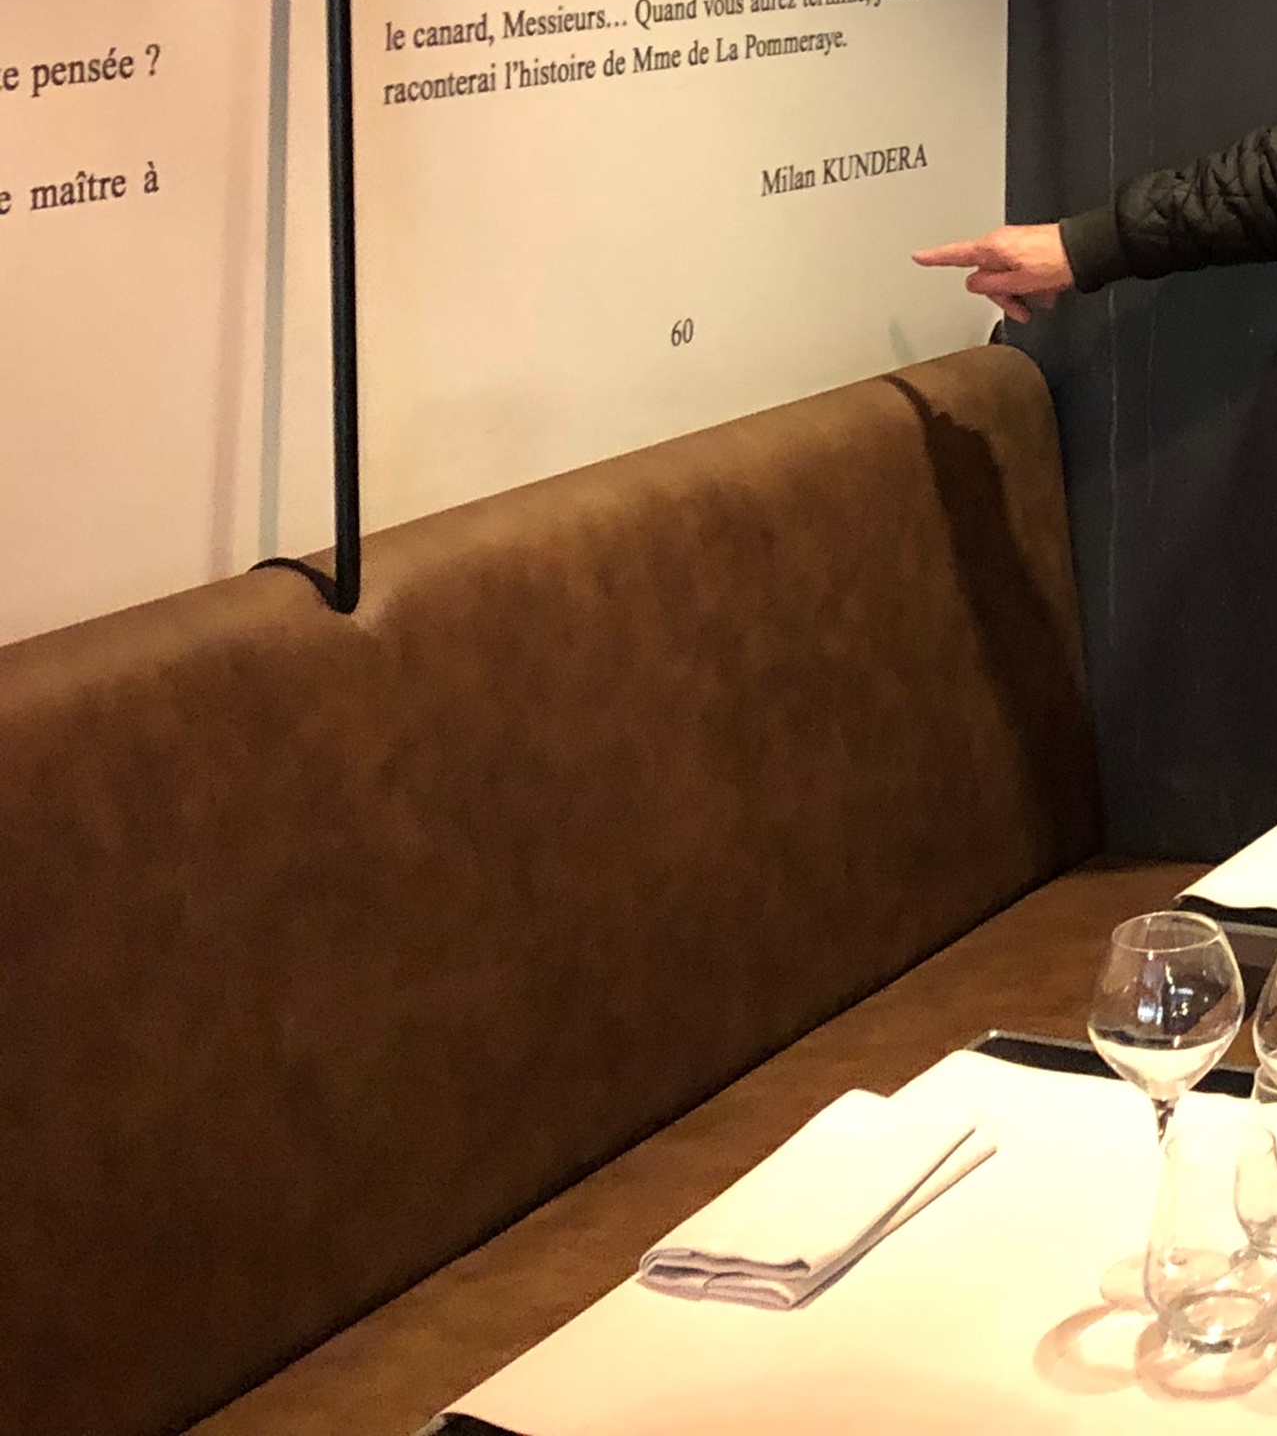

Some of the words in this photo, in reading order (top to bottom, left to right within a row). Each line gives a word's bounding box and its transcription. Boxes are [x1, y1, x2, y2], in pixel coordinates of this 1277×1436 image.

[384, 20, 406, 52] le
[412, 11, 495, 49] canard,
[31, 47, 135, 98] pensée
[382, 61, 496, 106] raconterai
[503, 52, 596, 90] l'histoire
[601, 48, 626, 78] de
[631, 44, 682, 74] Mme
[686, 38, 710, 67] de
[714, 36, 739, 63] La
[743, 30, 848, 60] Pommeraye.
[30, 170, 127, 212] maître
[144, 161, 160, 194] à
[760, 163, 816, 197] Milan
[821, 142, 928, 185] KUNDERA
[669, 318, 695, 348] 60
